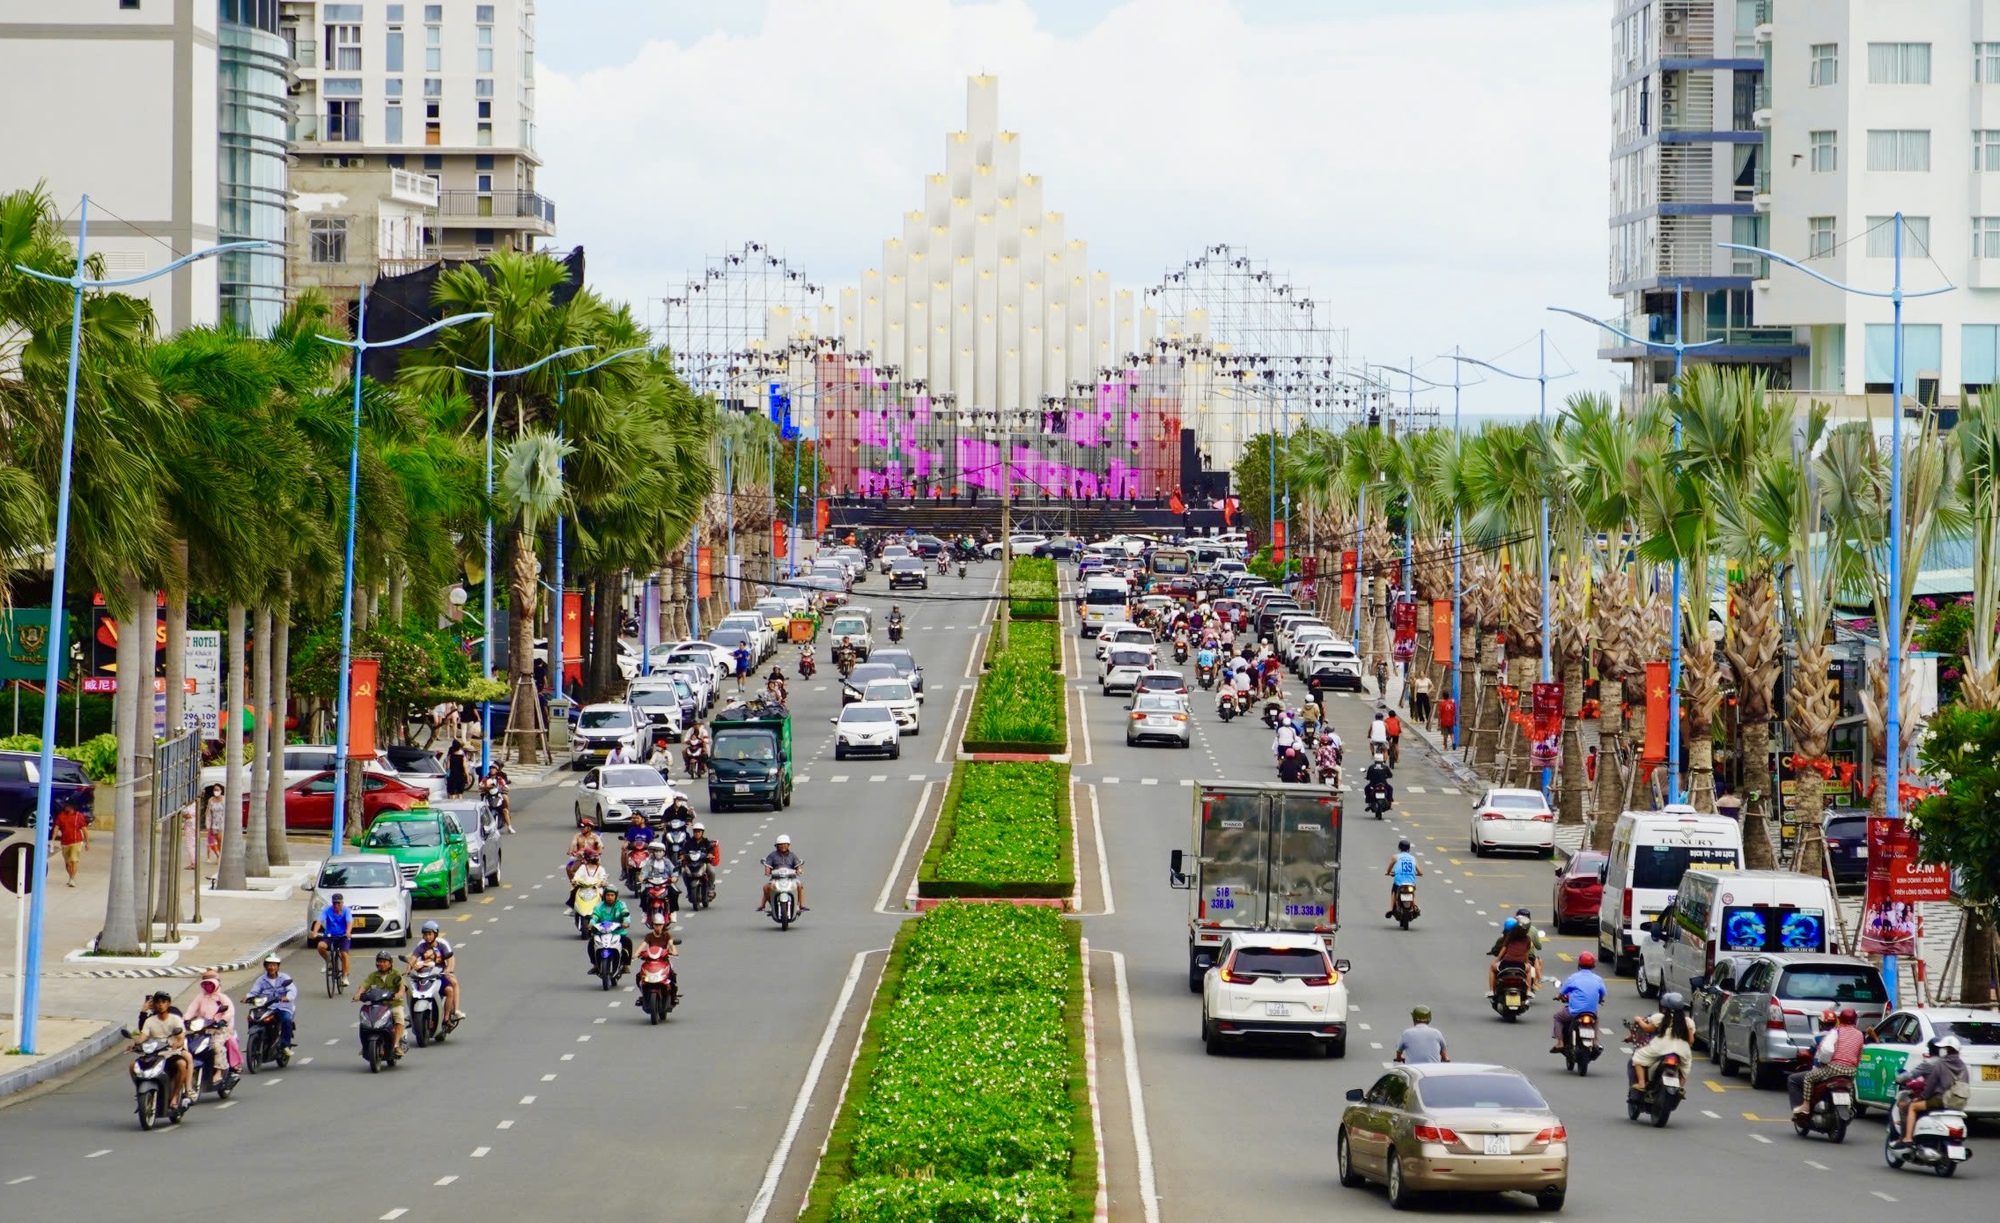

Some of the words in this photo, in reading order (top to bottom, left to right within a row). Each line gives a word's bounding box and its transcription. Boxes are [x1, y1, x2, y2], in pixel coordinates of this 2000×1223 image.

[193, 636, 218, 647] HOTEL
[1661, 837, 1715, 846] LUXURY
[1401, 861, 1413, 873] 139
[1216, 887, 1230, 897] 51B
[1487, 1145, 1508, 1154] 4014
